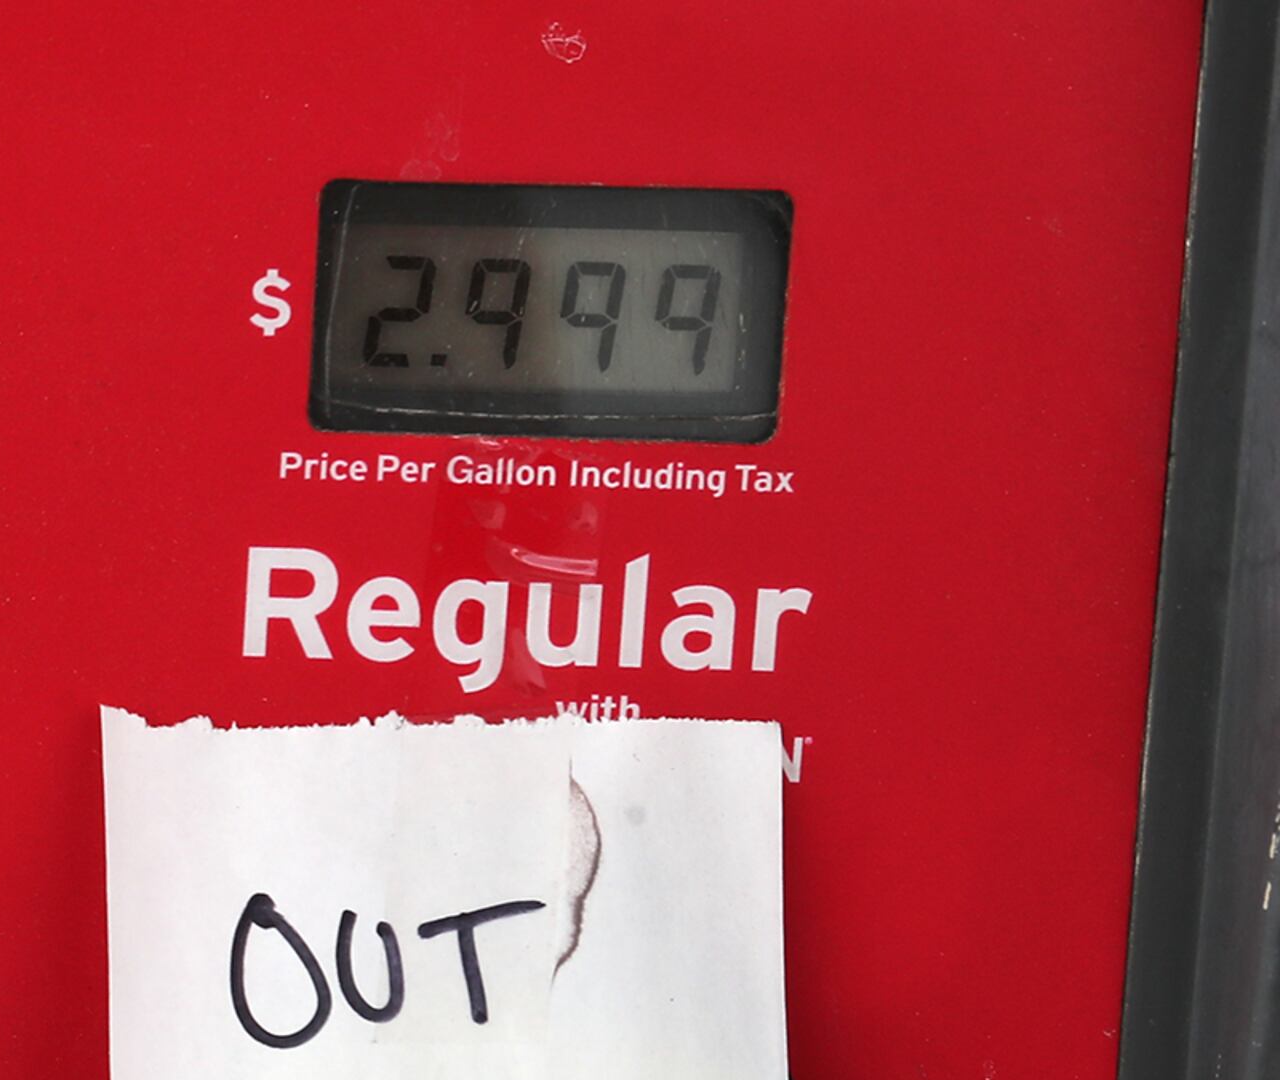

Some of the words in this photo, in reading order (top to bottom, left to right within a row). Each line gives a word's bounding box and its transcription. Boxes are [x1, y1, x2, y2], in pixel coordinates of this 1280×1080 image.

[249, 268, 292, 337] $
[362, 255, 722, 376] 2.999
[279, 451, 368, 481] Price
[377, 454, 436, 483] Per
[446, 455, 556, 487] Gallon
[570, 460, 726, 498] Including
[734, 464, 794, 493] Tax
[242, 546, 813, 693] Regular
[229, 892, 547, 1049] OUT
